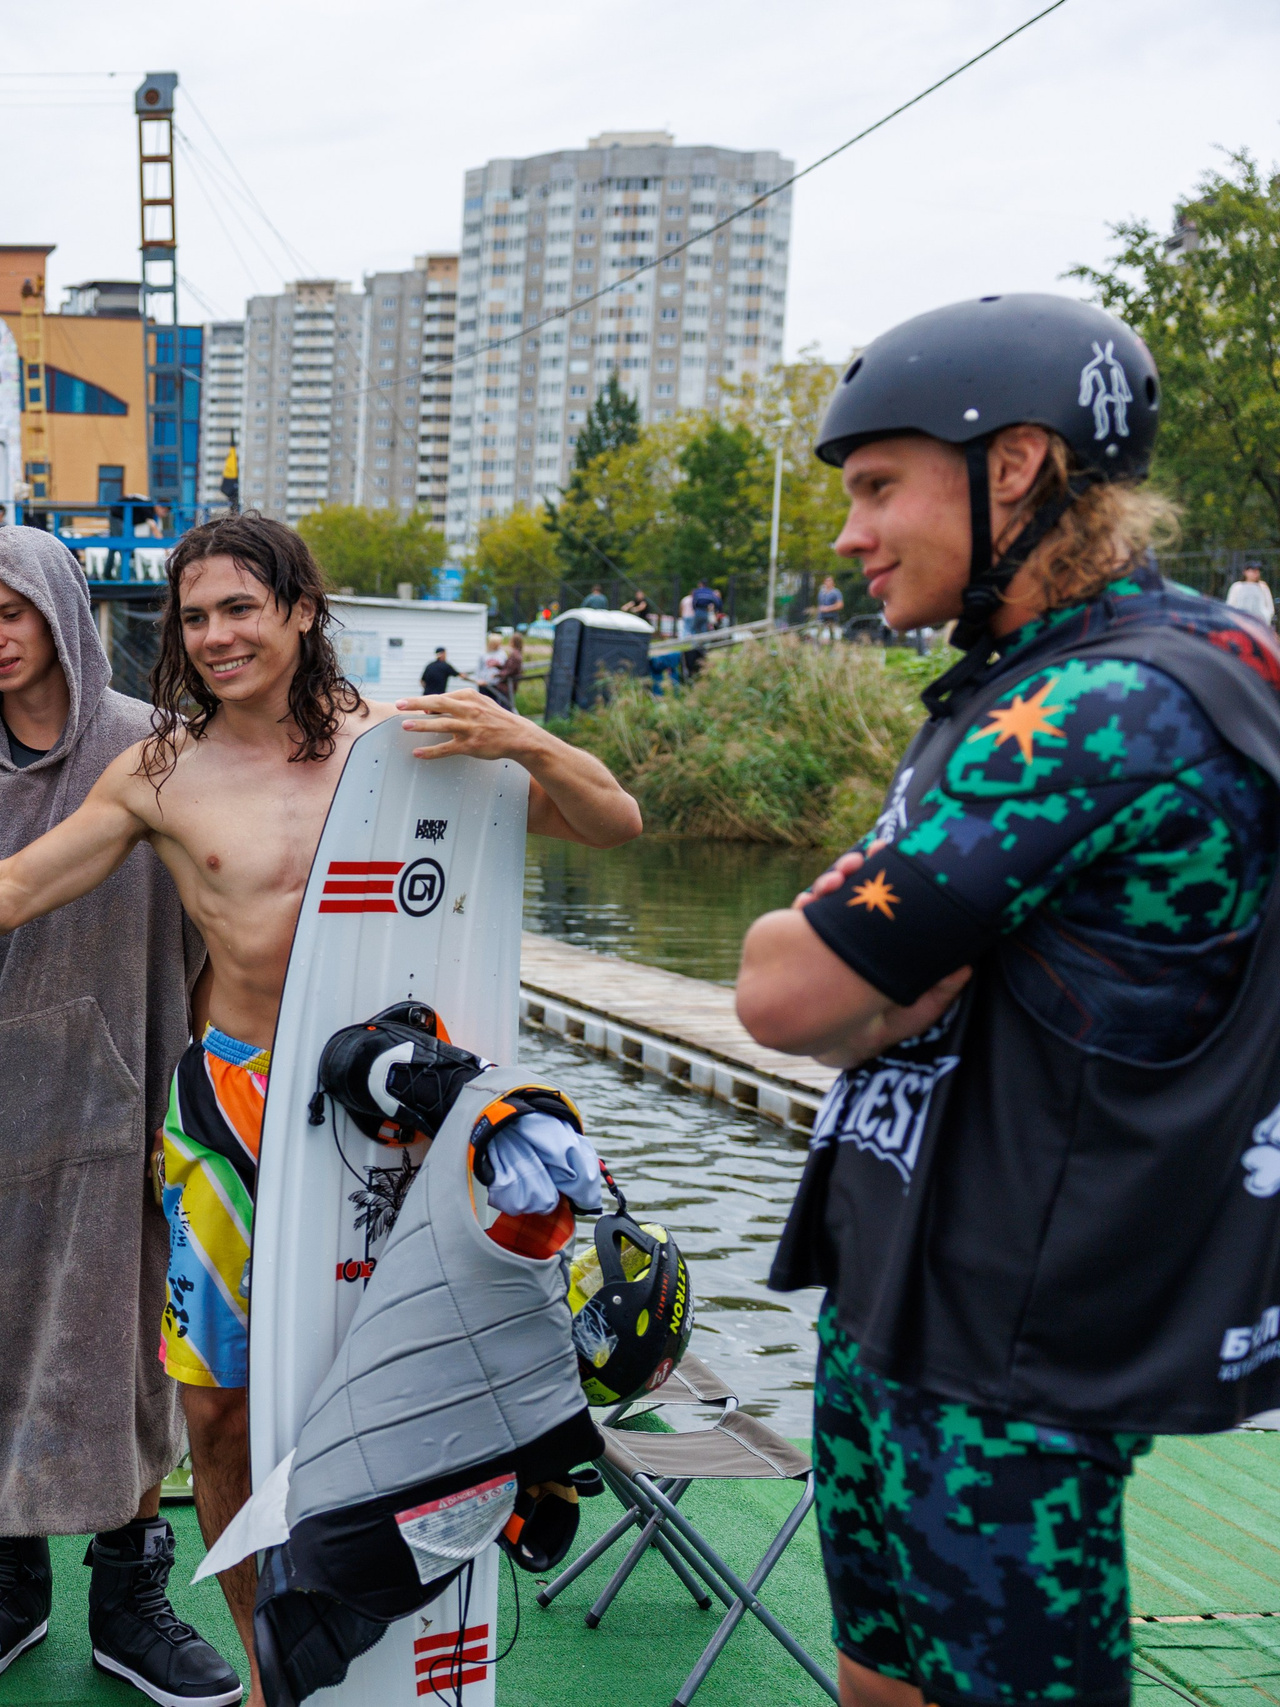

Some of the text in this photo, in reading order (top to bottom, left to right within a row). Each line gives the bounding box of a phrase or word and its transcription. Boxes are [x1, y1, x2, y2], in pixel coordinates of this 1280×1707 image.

[415, 828, 445, 846] PARK
[670, 1256, 686, 1335] AZTRON
[447, 1488, 478, 1506] DANGER
